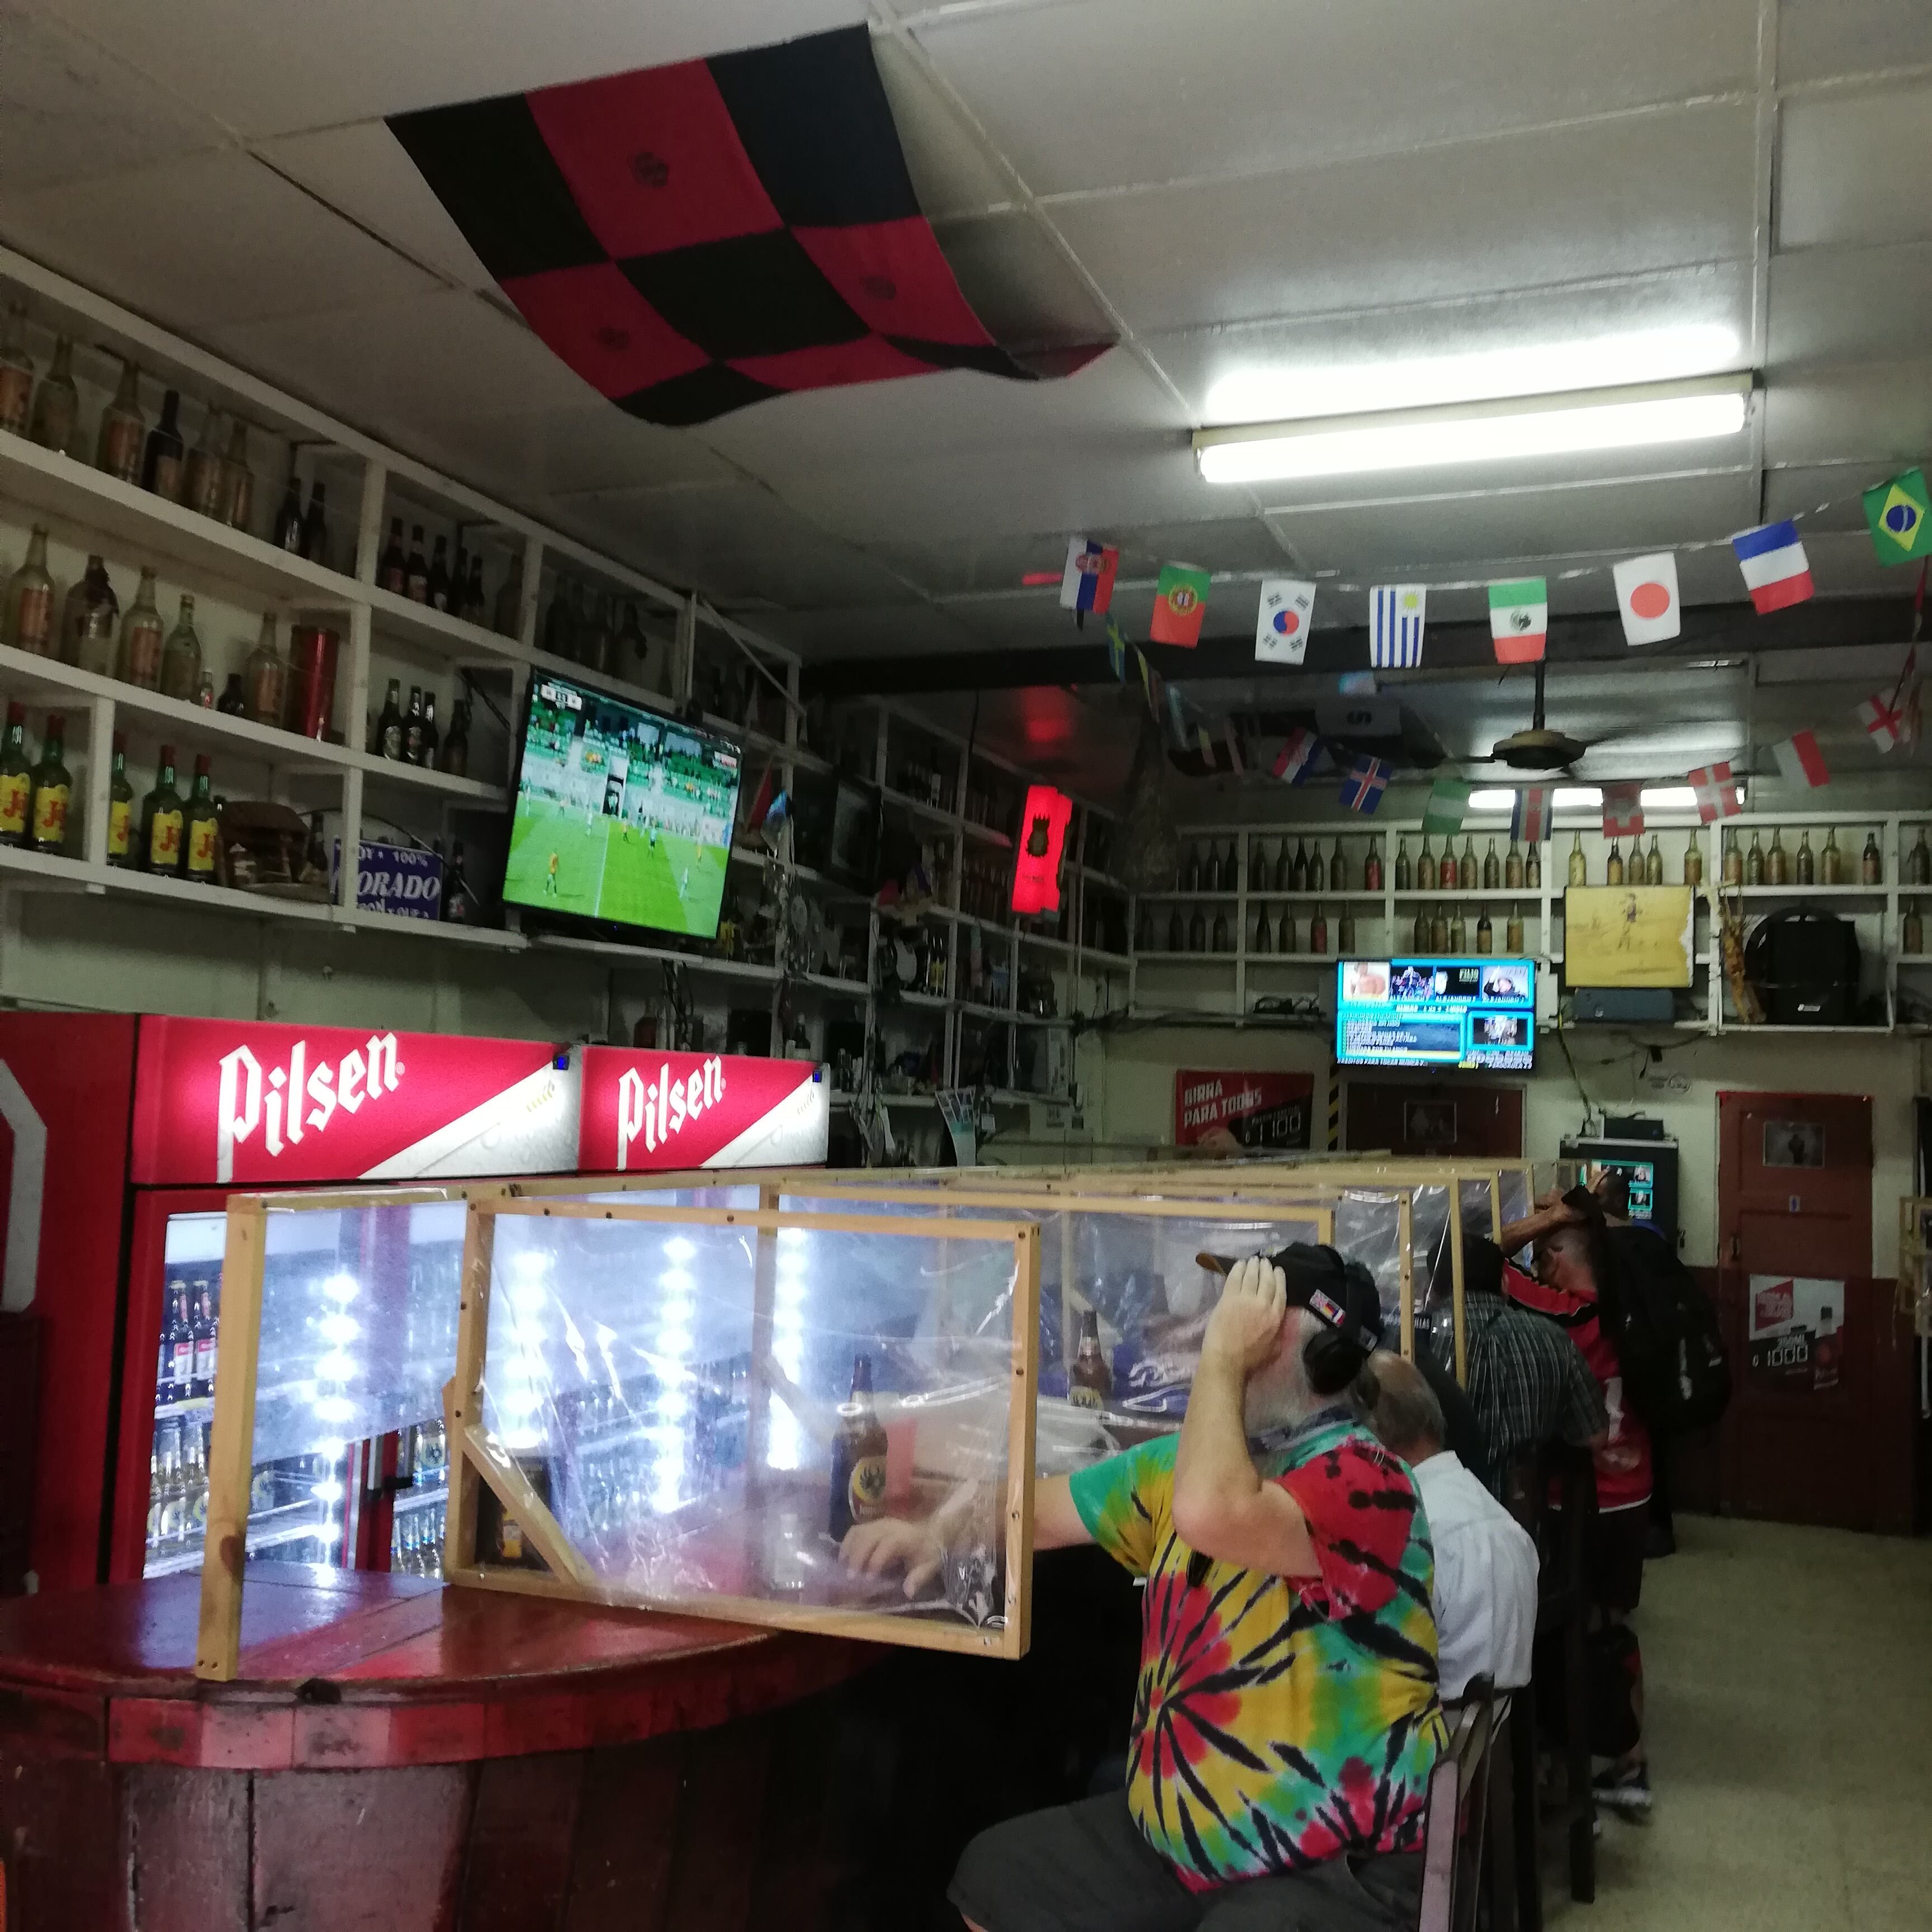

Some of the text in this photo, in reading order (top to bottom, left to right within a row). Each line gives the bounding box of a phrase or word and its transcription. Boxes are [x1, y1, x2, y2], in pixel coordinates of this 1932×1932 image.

[330, 867, 441, 902] ORADO
[216, 1032, 399, 1184] Pilsen
[617, 1054, 723, 1171] Pilsen
[1184, 1101, 1218, 1129] PARA
[1767, 1344, 1809, 1367] 1000
